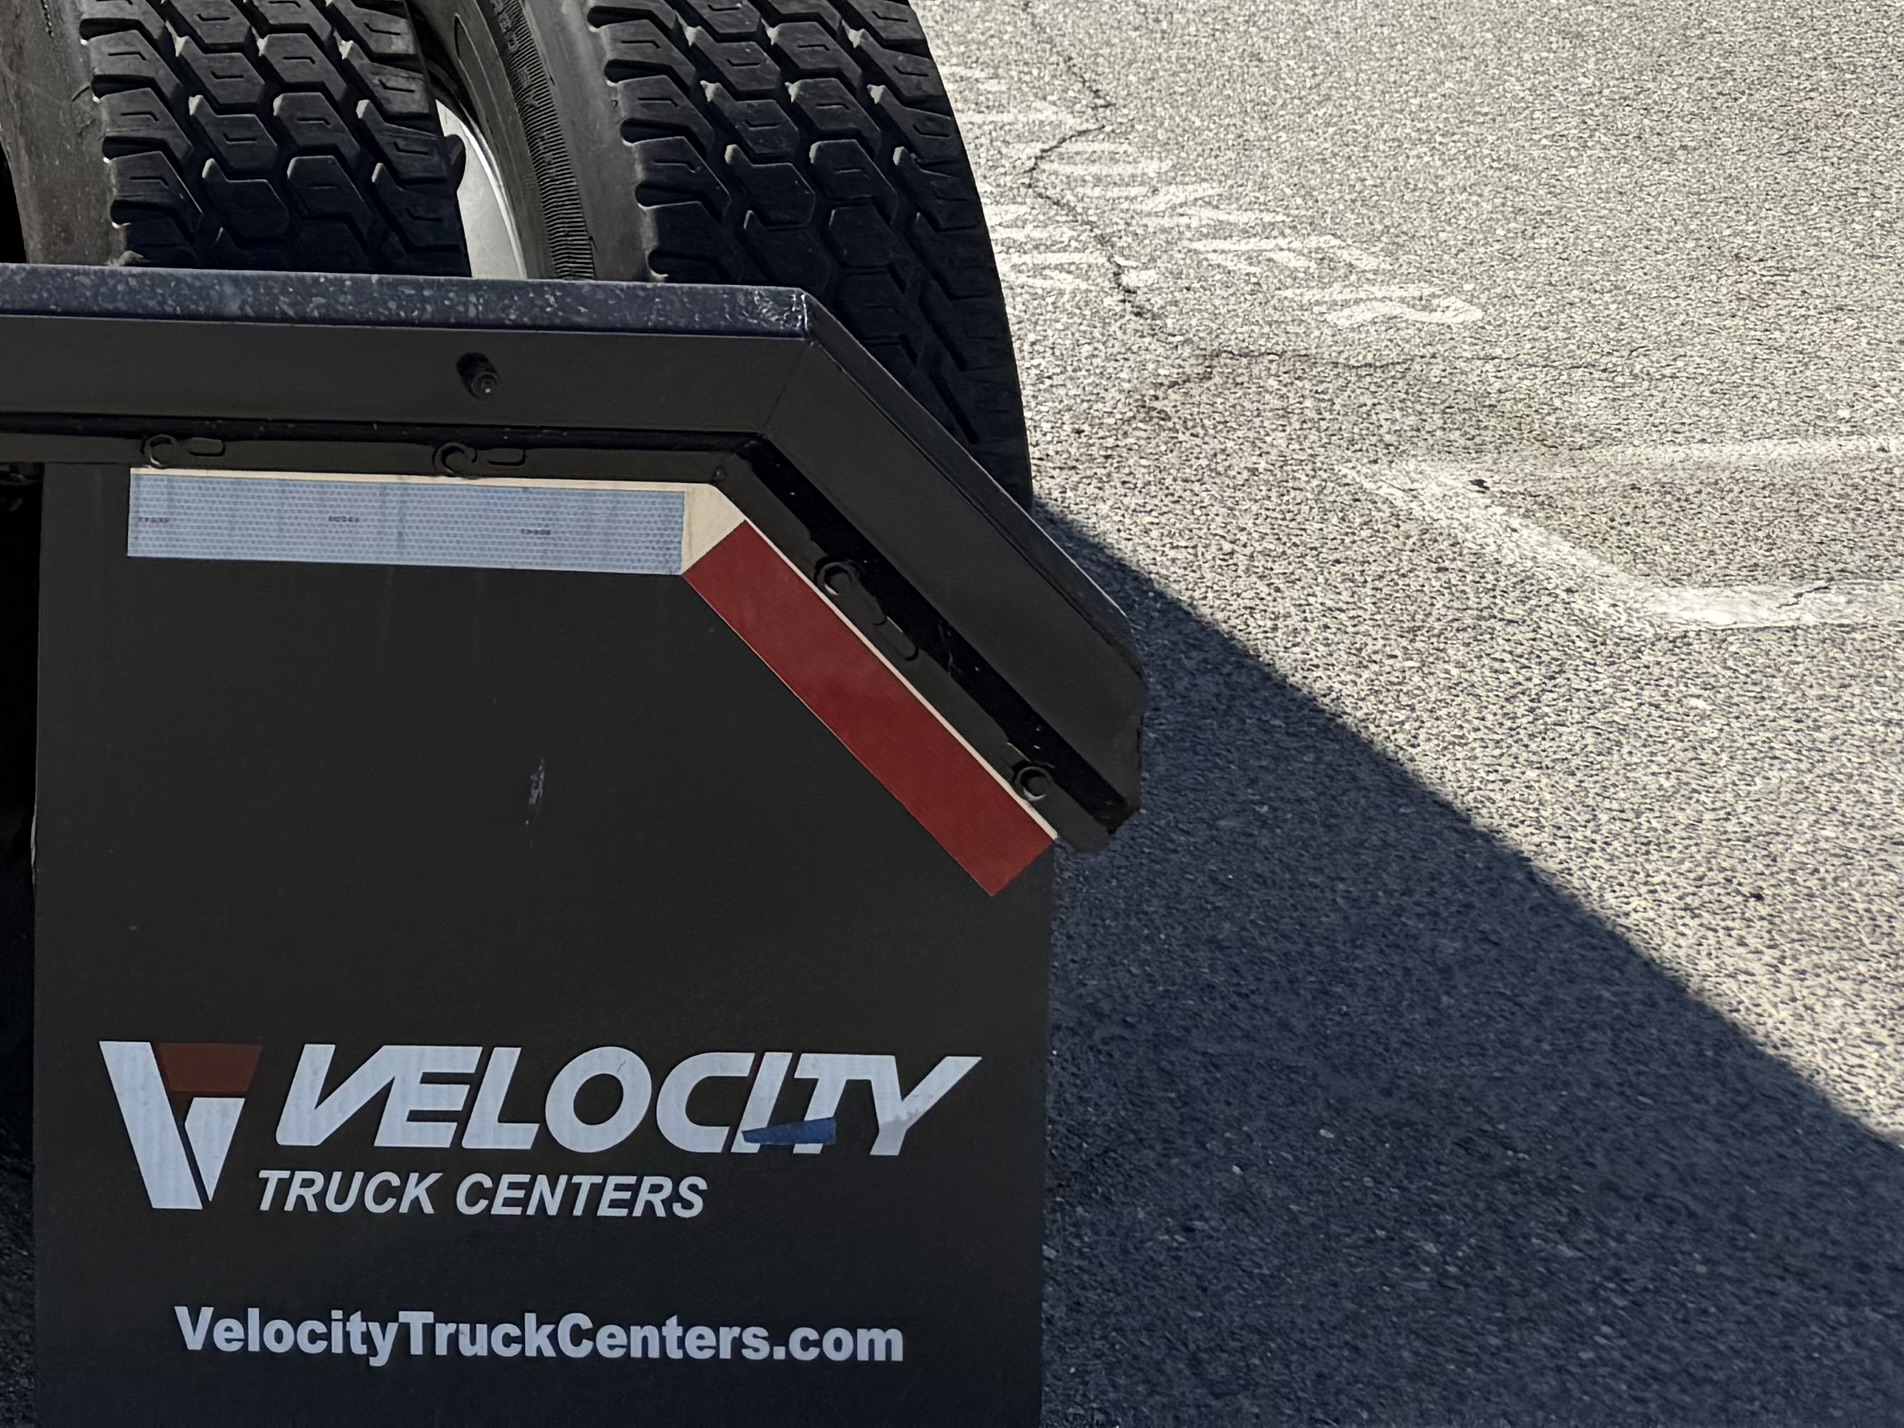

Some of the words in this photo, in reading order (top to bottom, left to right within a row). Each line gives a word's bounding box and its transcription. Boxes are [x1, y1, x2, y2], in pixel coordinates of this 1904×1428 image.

[275, 1043, 983, 1156] VELOCITY
[258, 1169, 443, 1215] TRUCK
[456, 1172, 708, 1219] CENTERS
[174, 1305, 904, 1367] VelocityTruckCenters.com
